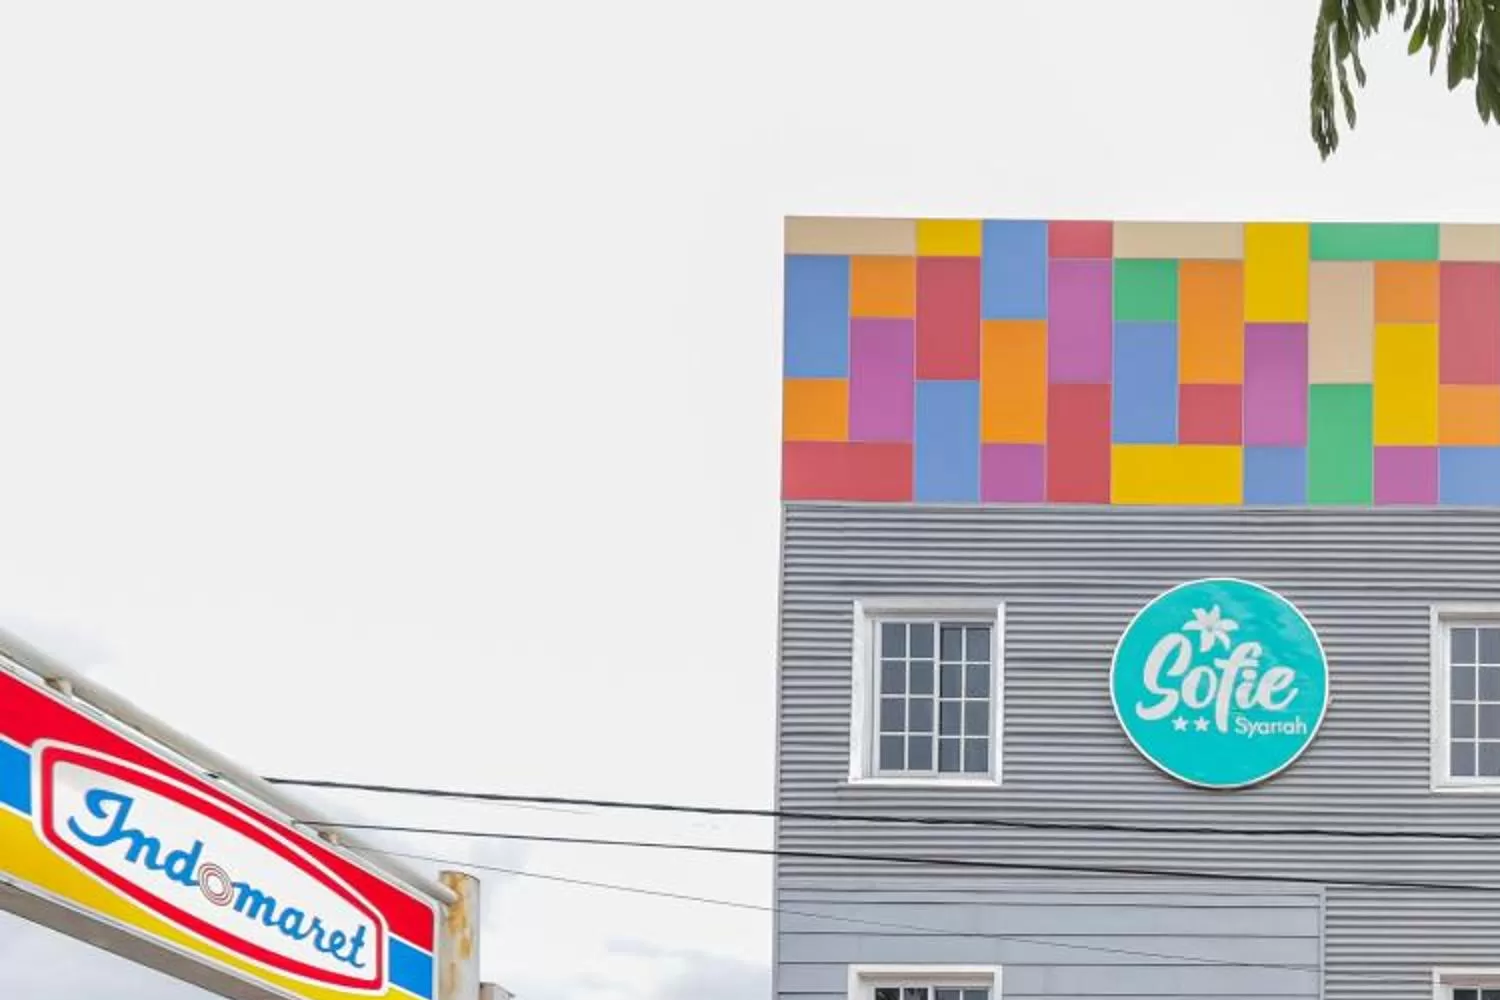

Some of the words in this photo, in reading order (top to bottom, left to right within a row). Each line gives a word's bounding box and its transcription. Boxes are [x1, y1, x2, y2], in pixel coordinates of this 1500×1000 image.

[1136, 632, 1299, 733] Sofie
[1235, 716, 1308, 738] Syariah
[67, 789, 367, 969] Indomaret
